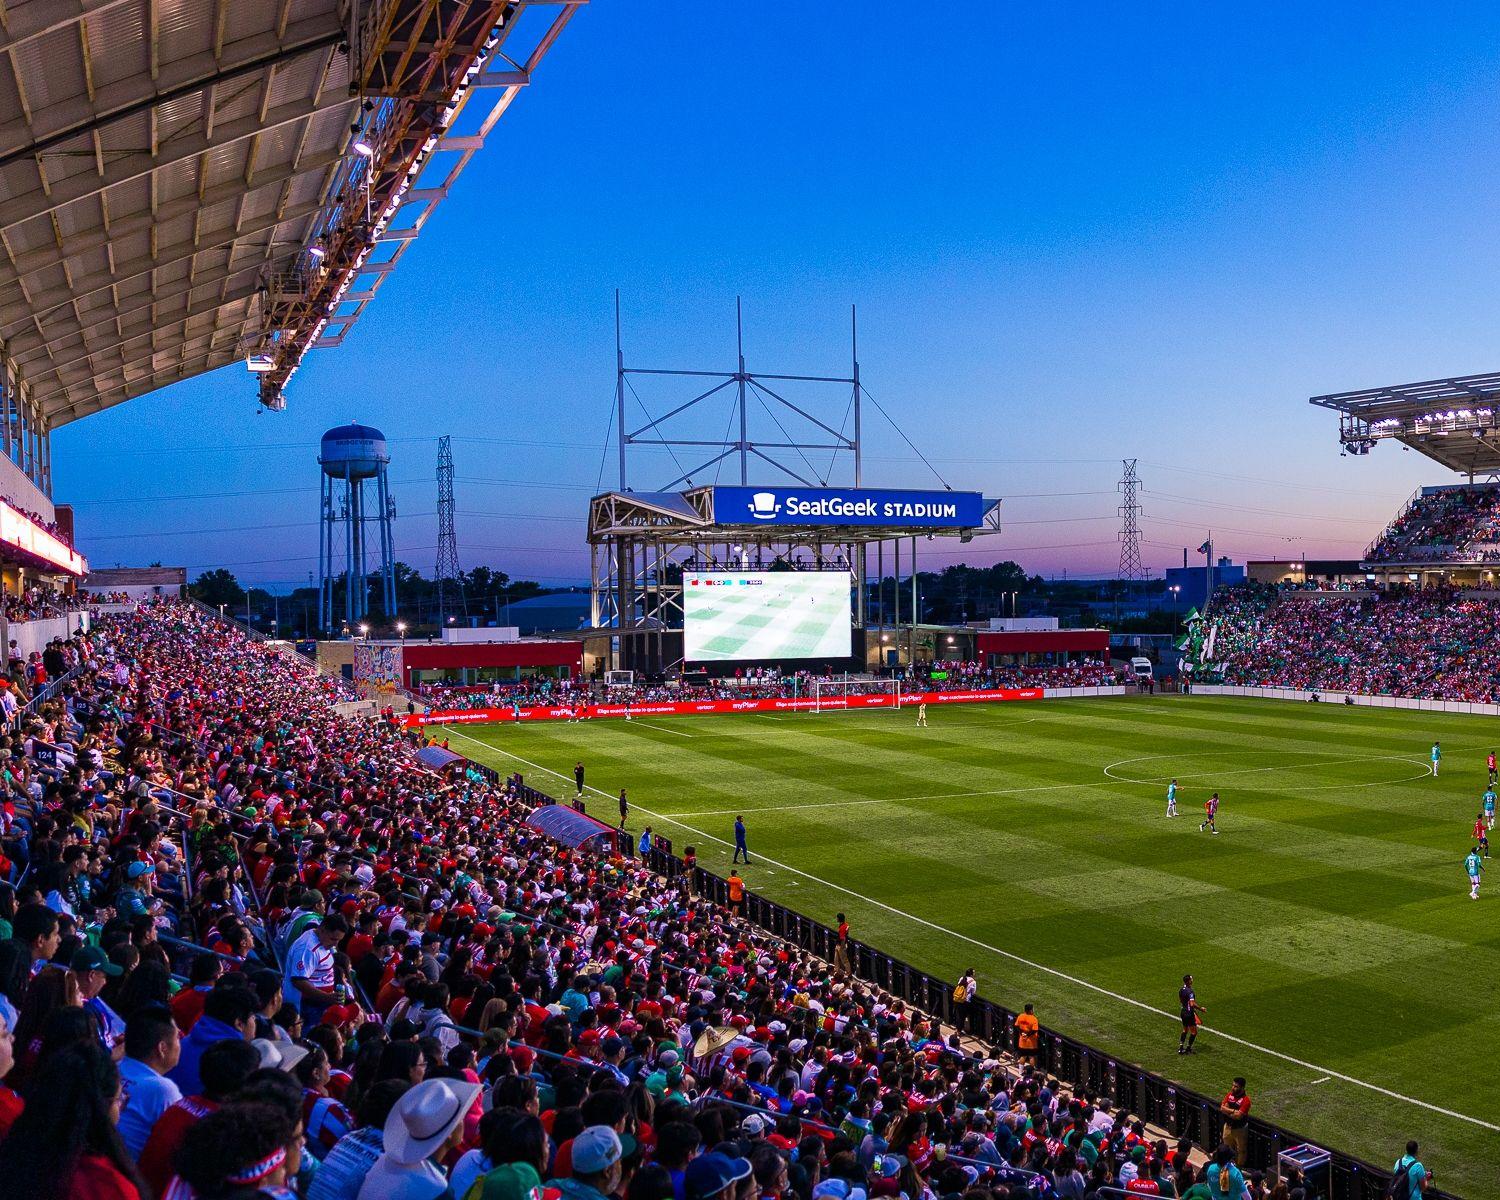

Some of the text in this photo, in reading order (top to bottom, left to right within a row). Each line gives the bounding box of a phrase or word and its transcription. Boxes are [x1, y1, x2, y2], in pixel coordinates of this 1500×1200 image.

[786, 497, 956, 518] SeatGeek STADIUM
[38, 751, 52, 759] 124
